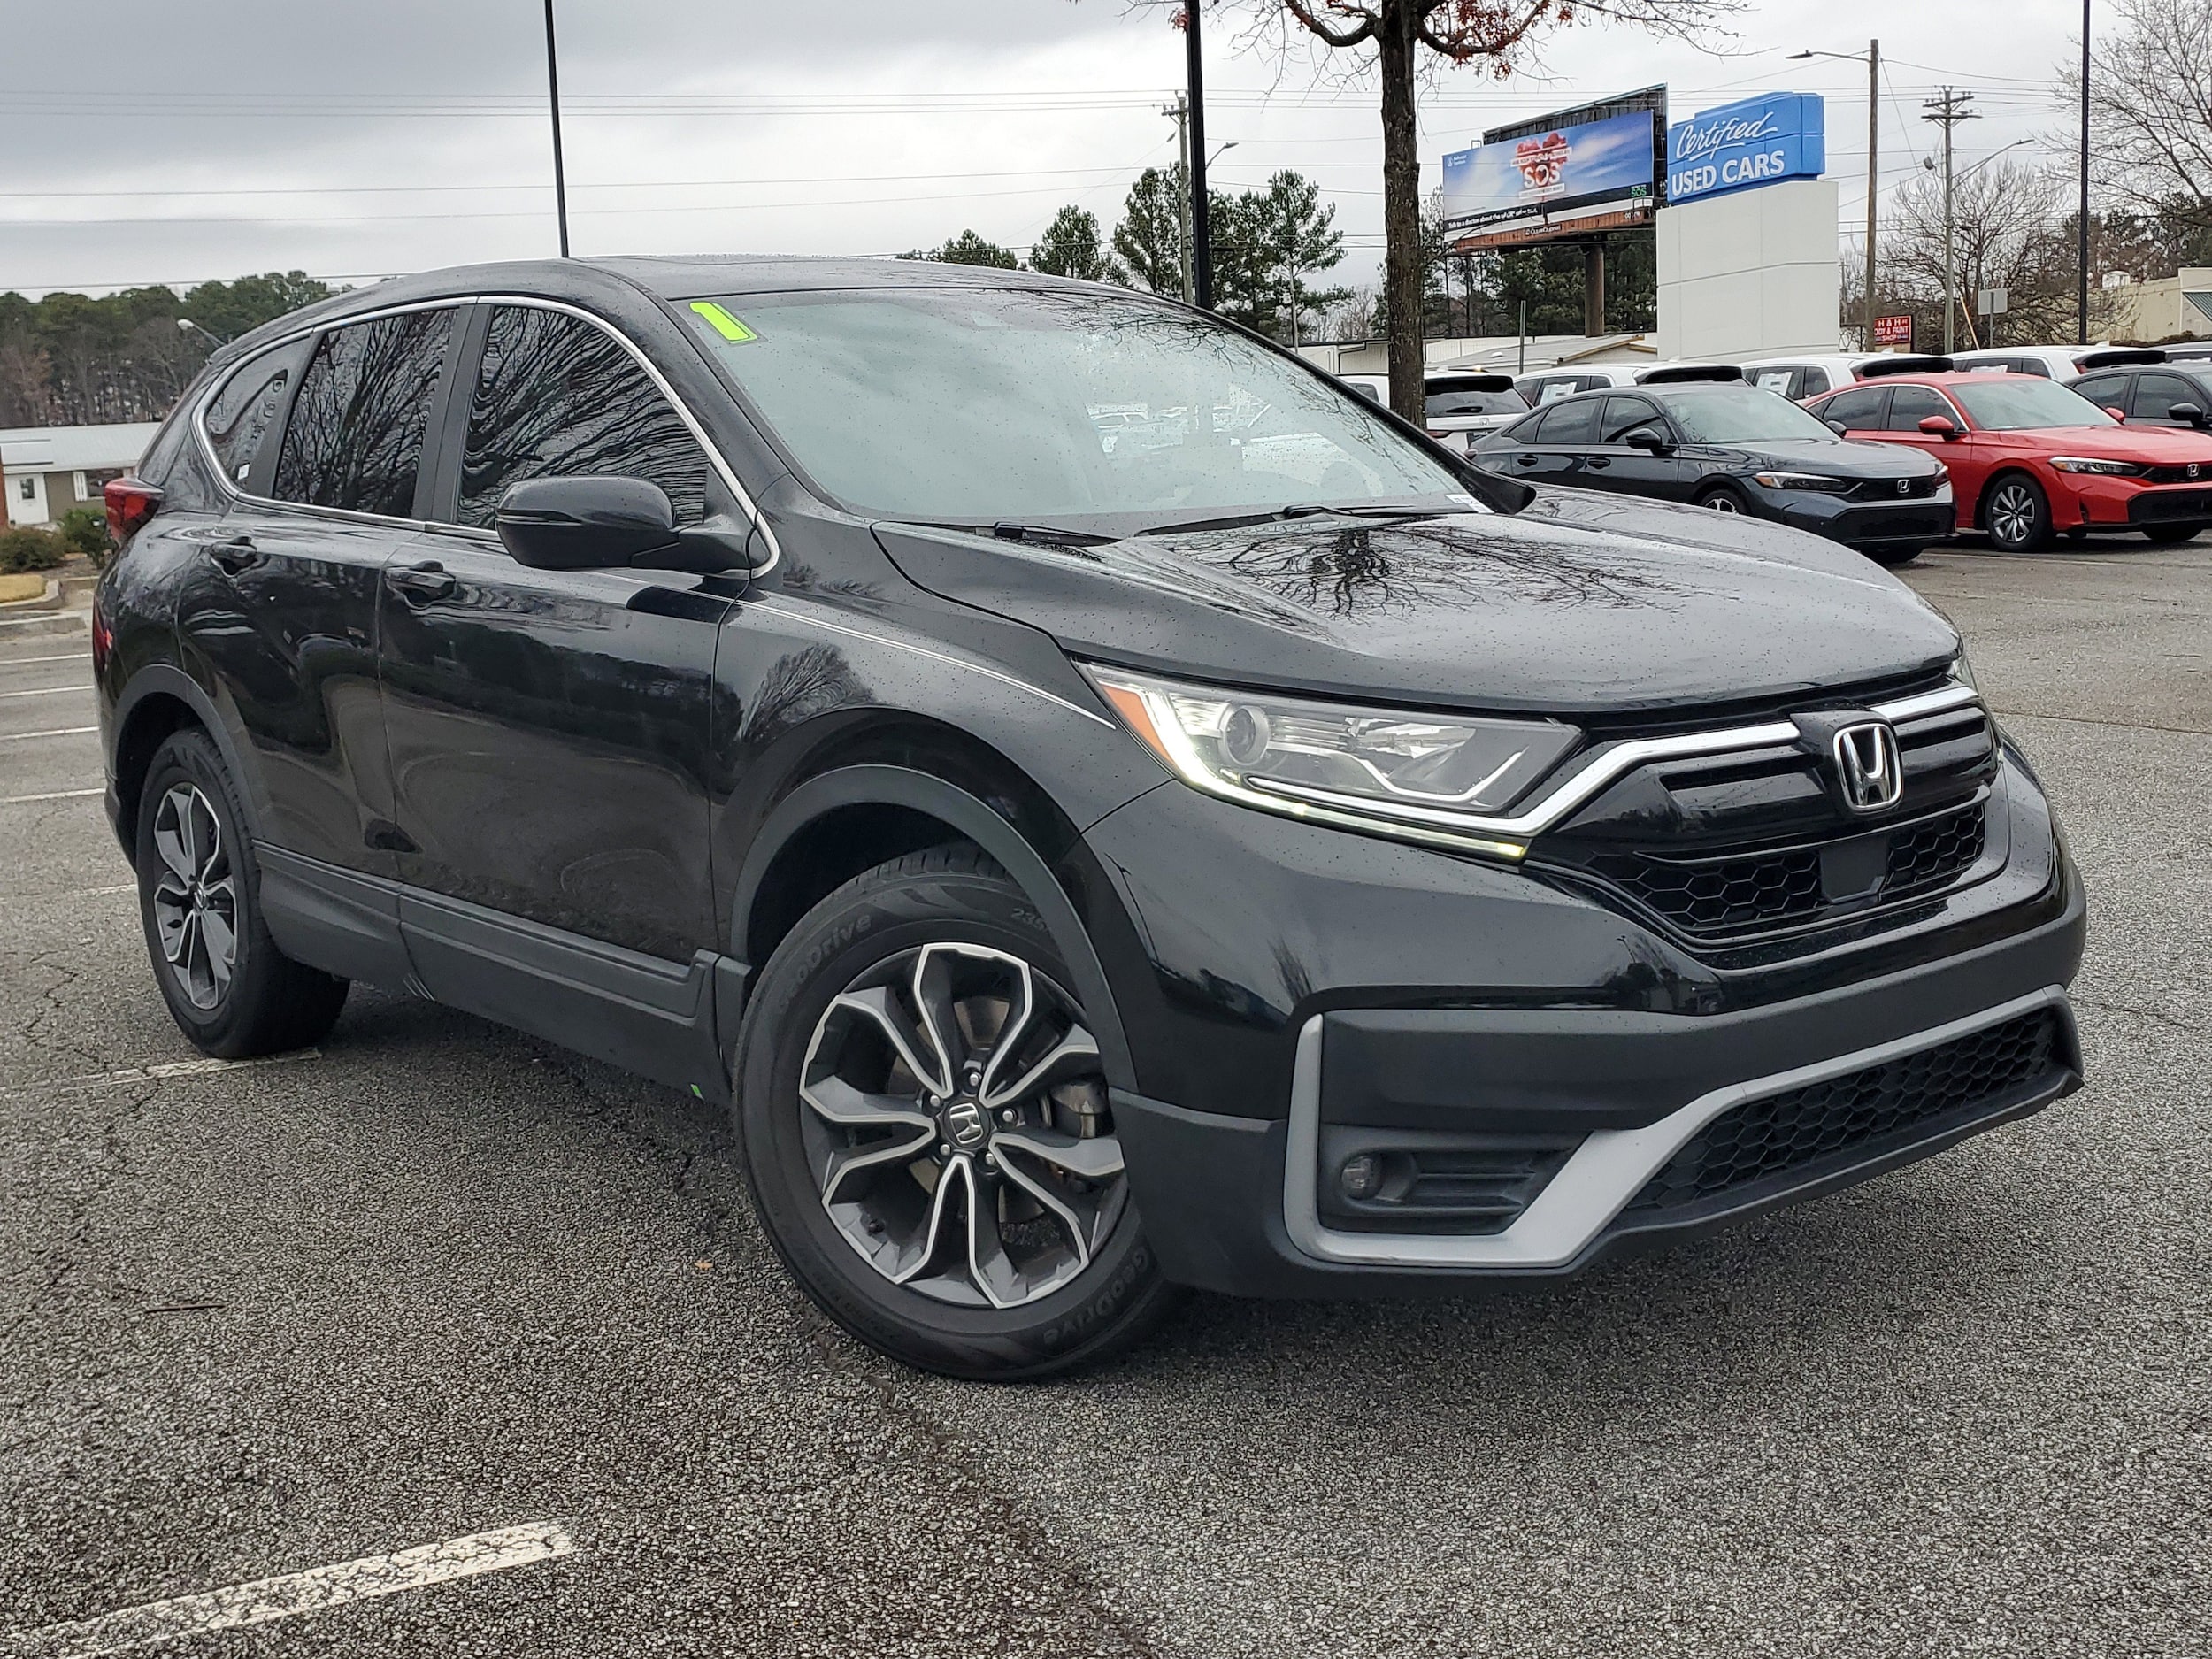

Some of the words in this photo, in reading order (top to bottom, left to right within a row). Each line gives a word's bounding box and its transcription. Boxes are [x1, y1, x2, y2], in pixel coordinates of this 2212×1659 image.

[1676, 111, 1778, 161] Certified
[1524, 162, 1561, 188] SOS
[1671, 165, 1717, 196] USED
[1722, 150, 1785, 183] CARS
